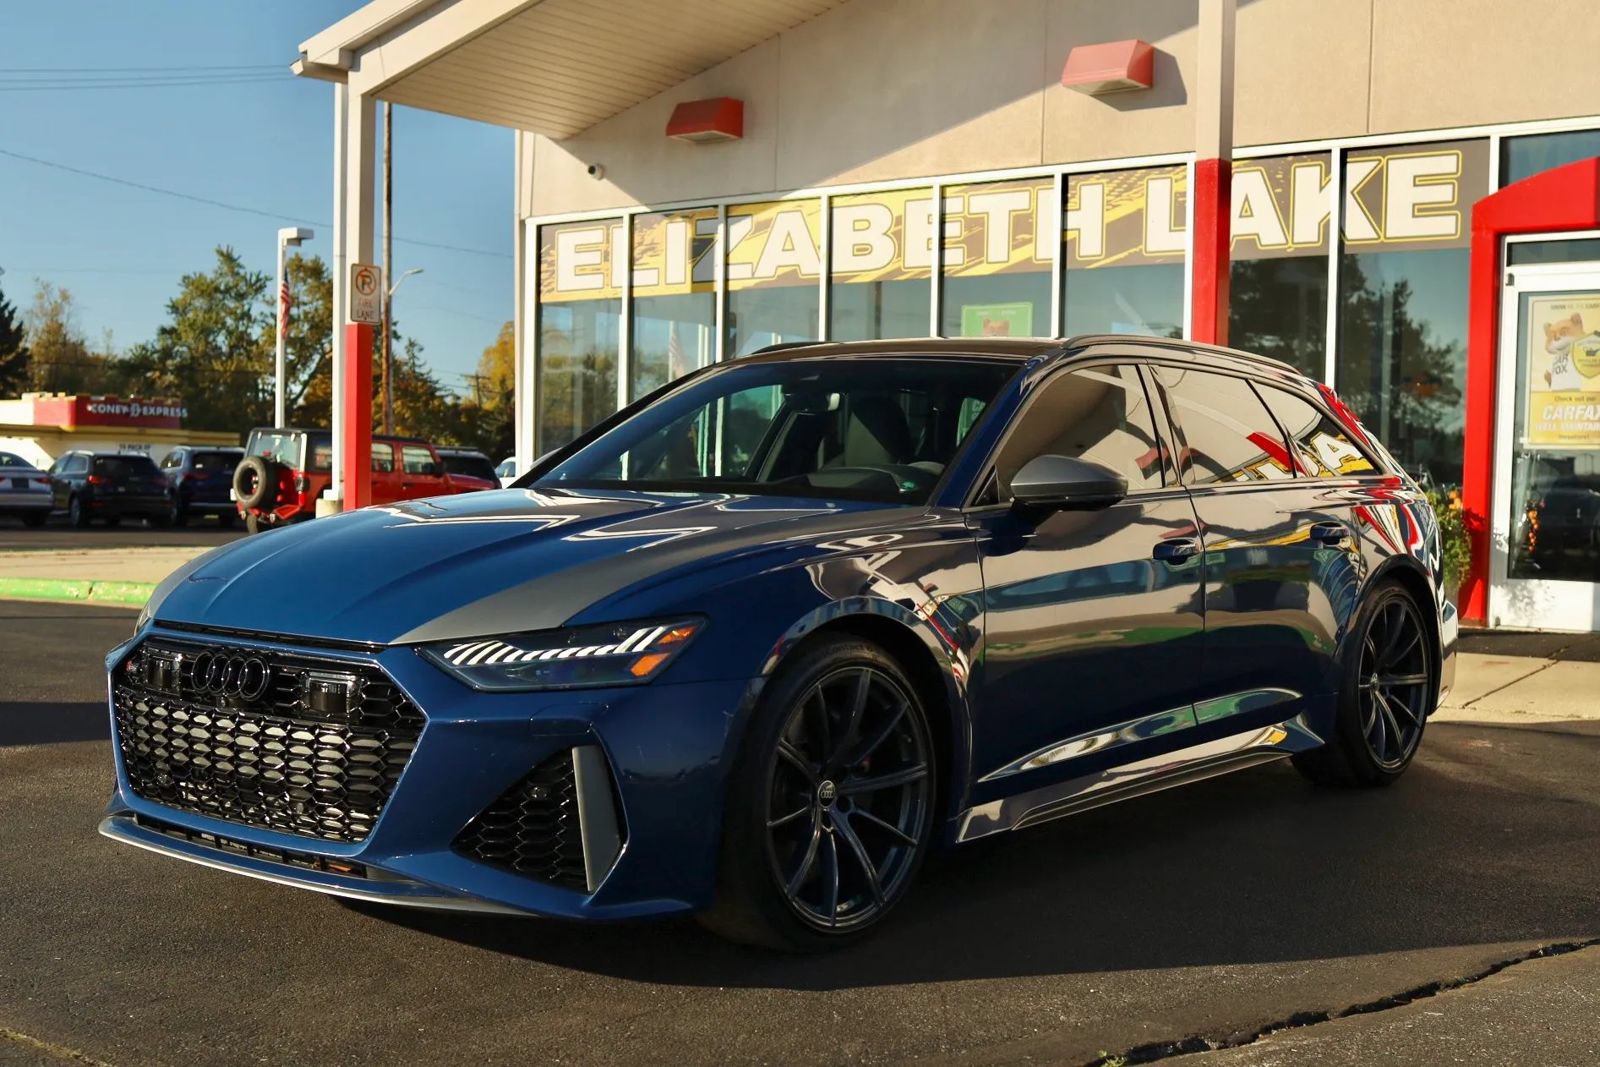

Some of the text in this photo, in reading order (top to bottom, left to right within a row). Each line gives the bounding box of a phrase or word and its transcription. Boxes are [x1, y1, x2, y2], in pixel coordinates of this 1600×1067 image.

[556, 152, 1460, 293] ELIZABETH LAKE
[91, 404, 188, 417] CONEY EXPRESS
